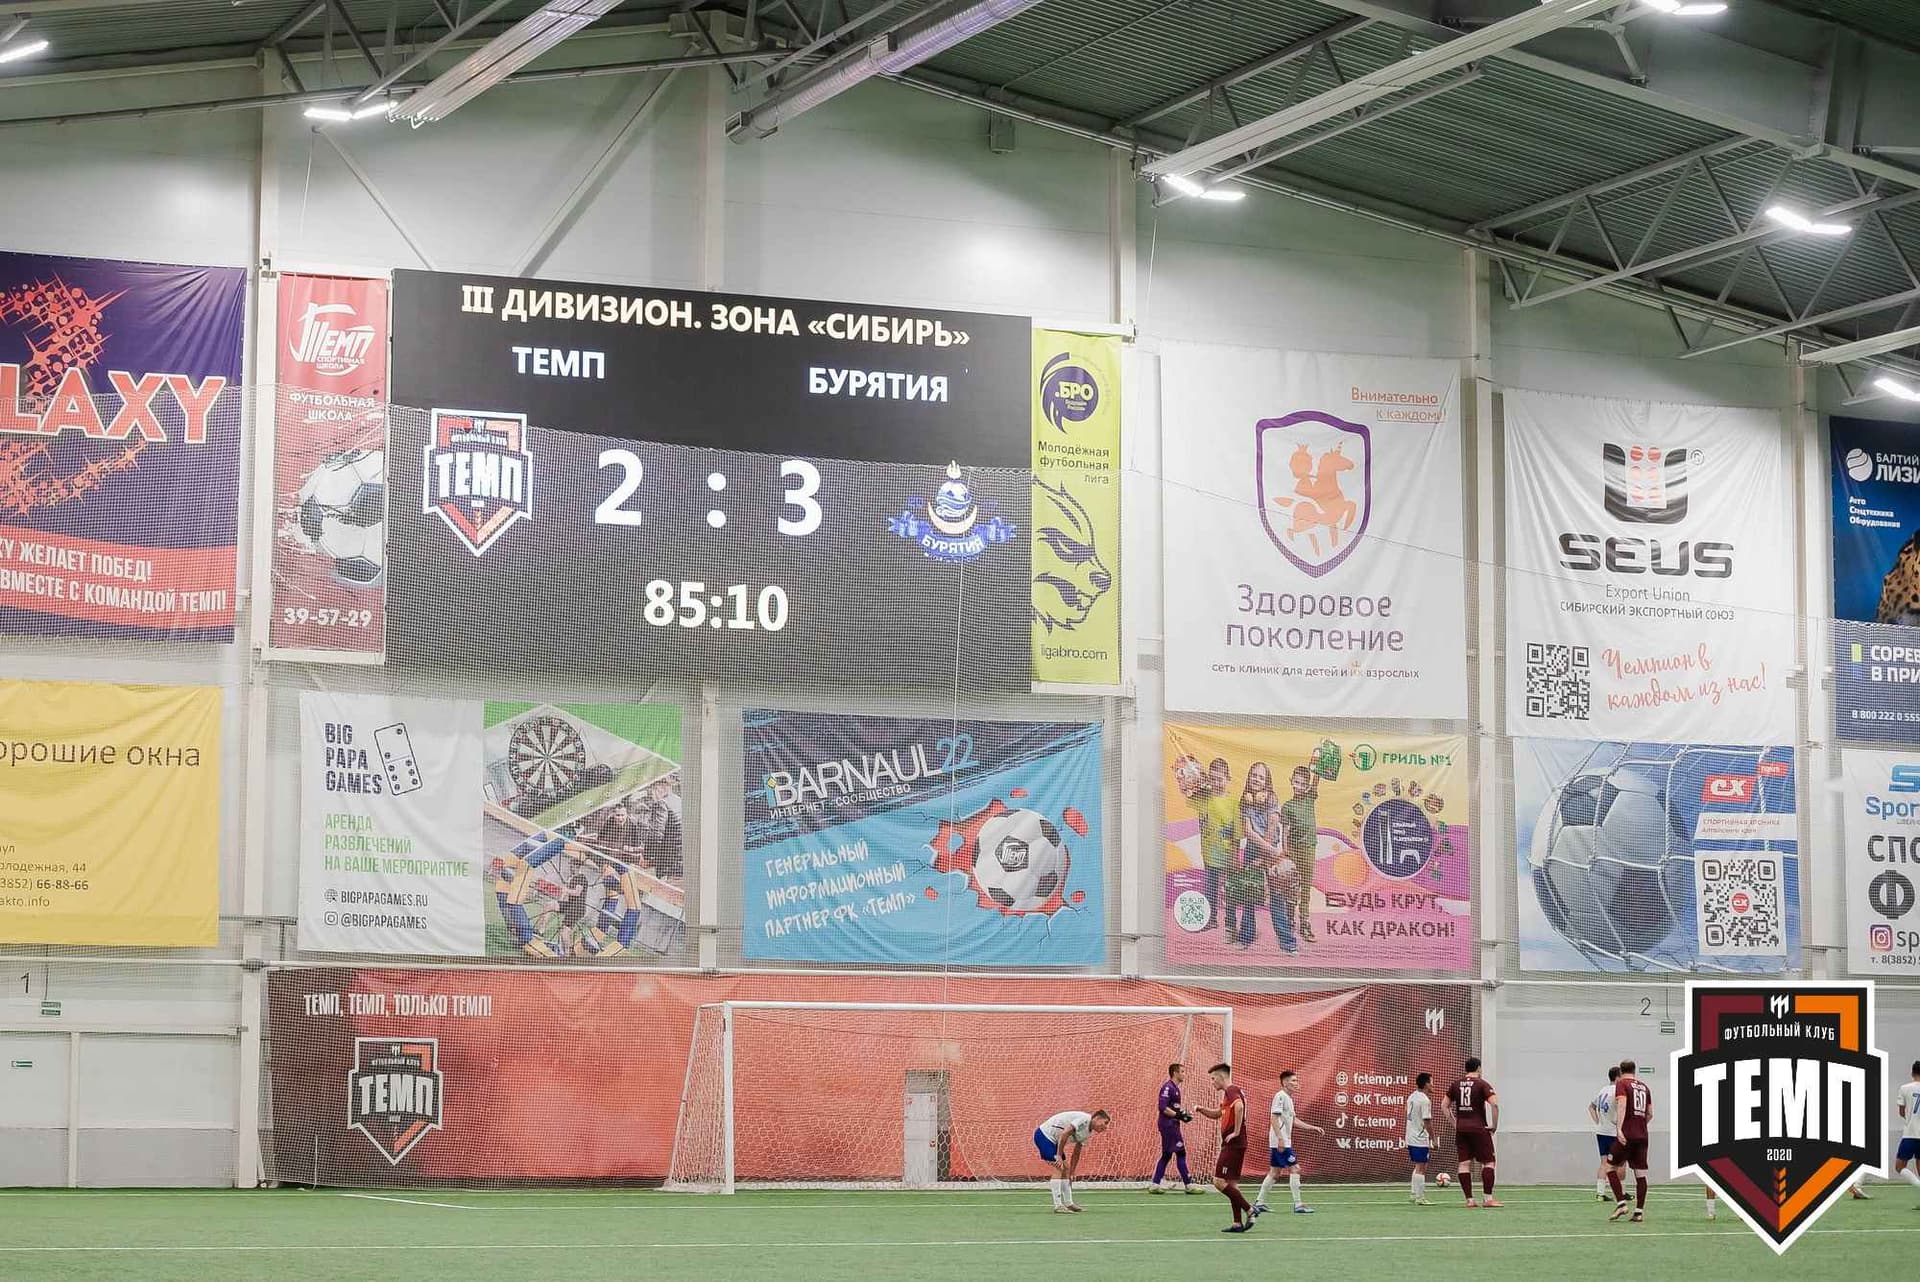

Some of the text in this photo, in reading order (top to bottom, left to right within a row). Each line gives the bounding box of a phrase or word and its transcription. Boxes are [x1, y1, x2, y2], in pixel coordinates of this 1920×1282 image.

[461, 285, 970, 348] III ДИВИЗИОН. ЗОНА «СИБИРЬ»
[288, 302, 376, 362] ТЕМП
[512, 346, 948, 402] ТЕМП БУРЯТИЯ
[290, 392, 375, 408] ФУТБОЛЬНАЯ
[1352, 386, 1439, 405] Внимательно
[308, 409, 353, 421] ШКОЛА
[1386, 408, 1447, 421] каждому!
[1038, 441, 1110, 458] Молодёжная
[1876, 453, 1919, 466] БАЛТИЙ
[1039, 456, 1109, 470] футбольная
[436, 451, 522, 503] ТЕМП
[1084, 474, 1109, 485] лига
[594, 449, 823, 537] 2 : 3
[921, 534, 985, 554] БУРЯТИЯ
[20, 542, 87, 571] ЖЕЛАЕТ
[91, 554, 152, 583] ПОБЕД!
[1558, 533, 1735, 579] SEUS
[0, 569, 227, 613] ВМЕСТЕ С КОМАНДОЙ ТЕМП!
[1237, 583, 1393, 619] Здоровое
[1606, 584, 1691, 602] Export Union
[643, 579, 789, 631] 85:10
[1560, 601, 1735, 621] СИБИРСКИЙ ЭКСПОРТНЫЙ СОЮЗ
[284, 607, 372, 627] 39-57-29
[1225, 623, 1405, 652] поколение
[1040, 644, 1108, 661] ligabro.com
[1601, 642, 1712, 680] Чемпион в
[1211, 663, 1236, 674] сеть
[1238, 664, 1279, 676] клиник
[1281, 667, 1303, 677] для
[1305, 666, 1339, 677] детей
[1341, 668, 1348, 677] и
[1366, 669, 1420, 680] взрослых
[1871, 666, 1882, 681] В
[1607, 662, 1767, 711] каждом из нас!
[1860, 710, 1876, 720] 800
[1878, 711, 1895, 721] 222
[325, 722, 353, 745] BIG
[127, 745, 200, 767] окна
[325, 747, 369, 770] PAPA
[1382, 753, 1452, 767] ГРИЛЬ №1
[325, 770, 383, 794] GAMES
[769, 783, 911, 819] ИНТЕРНЕТ СООБЩЕСТВО
[325, 813, 373, 832] АРЕНДА
[0, 845, 15, 855] ул
[325, 835, 412, 854] РАЗВЛЕЧЕНИЙ
[72, 863, 86, 873] 44
[324, 855, 470, 877] НА ВАШЕ МЕРОПРИЯТИЕ
[765, 838, 869, 878] ГЕНЕРАЛЬНЫЙ
[37, 879, 89, 890] 66-88-66
[766, 860, 906, 910] ИНФОРМАЦИОННЫЙ
[1868, 870, 1915, 919] Ф
[341, 890, 428, 907] BIGPAPAGAMES.RU
[1325, 891, 1443, 912] БУДЬ КРУТ,
[341, 912, 428, 930] @BIGPAPAGAMES
[764, 893, 916, 939] ПАРТНЕР ФК «ТЕМП»
[1326, 919, 1455, 940] КАК ДРАКОН!
[1881, 954, 1917, 966] 8(3852)
[20, 972, 30, 994] 1
[304, 993, 492, 1017] ТЕМП, ТЕМП, ТОЛЬКО ТЕМП!
[1640, 997, 1652, 1016] 2
[1354, 1072, 1408, 1086] fctemp.ru
[358, 1073, 433, 1116] ТЕМП
[1354, 1094, 1404, 1105] ФК Темп
[1459, 1086, 1472, 1107] 13
[1633, 1089, 1647, 1112] 60
[1353, 1115, 1397, 1130] fc.temp
